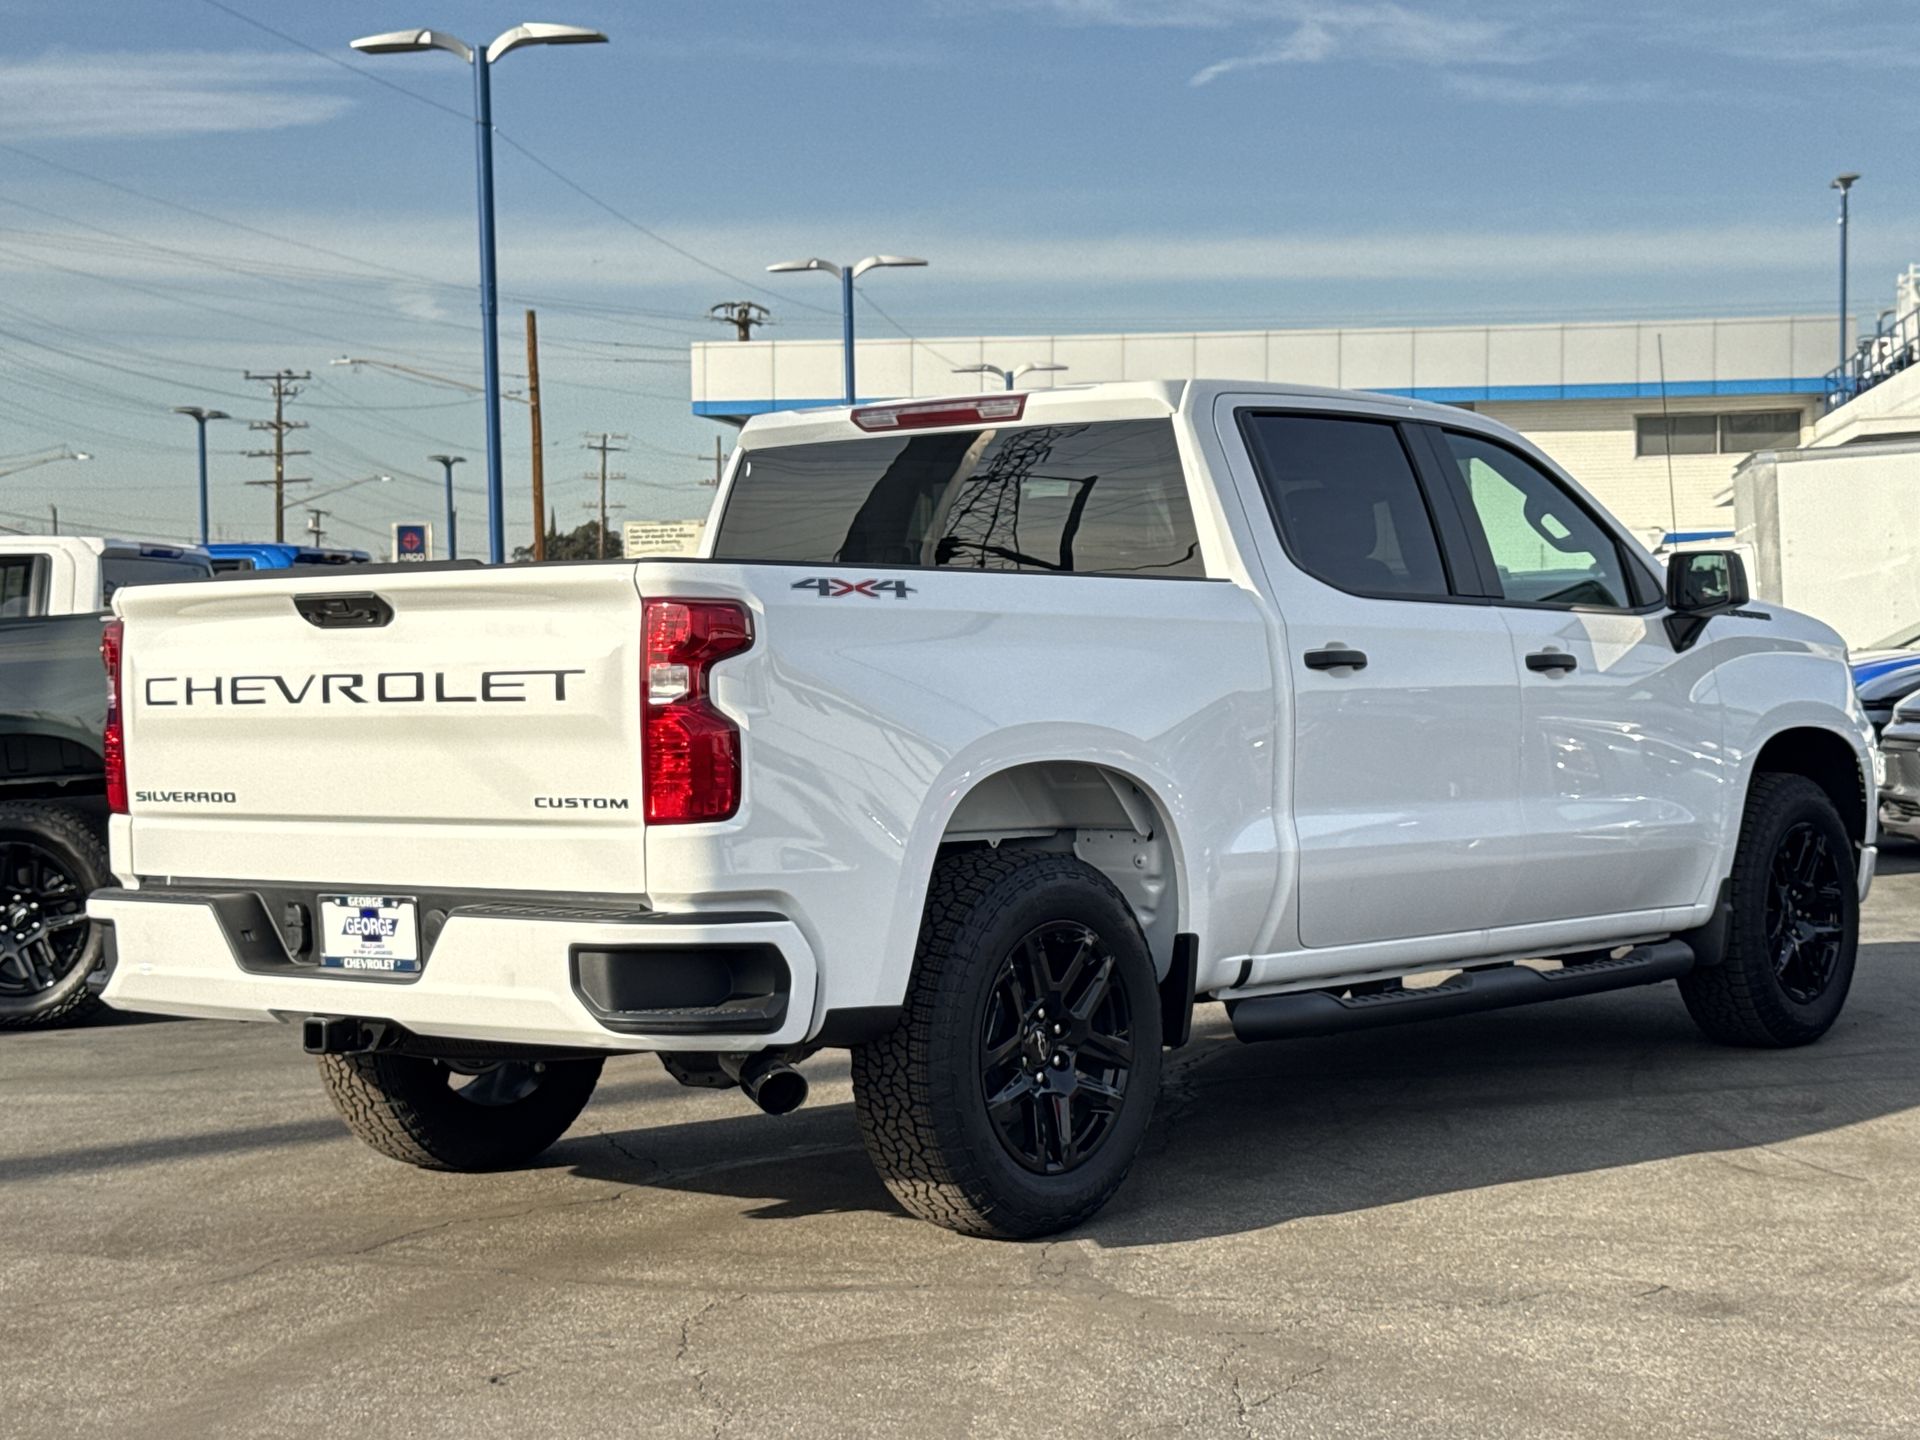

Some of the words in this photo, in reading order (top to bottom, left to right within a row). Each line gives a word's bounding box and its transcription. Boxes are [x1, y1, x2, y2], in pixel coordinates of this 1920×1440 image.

[400, 553, 425, 561] ARCO
[145, 668, 586, 706] CHEVROLET
[135, 791, 237, 804] SILVERADO
[534, 796, 629, 810] CUSTOM
[347, 896, 384, 908] GEORGE
[346, 917, 394, 936] GEORGE
[344, 958, 394, 970] CHEVROLET
